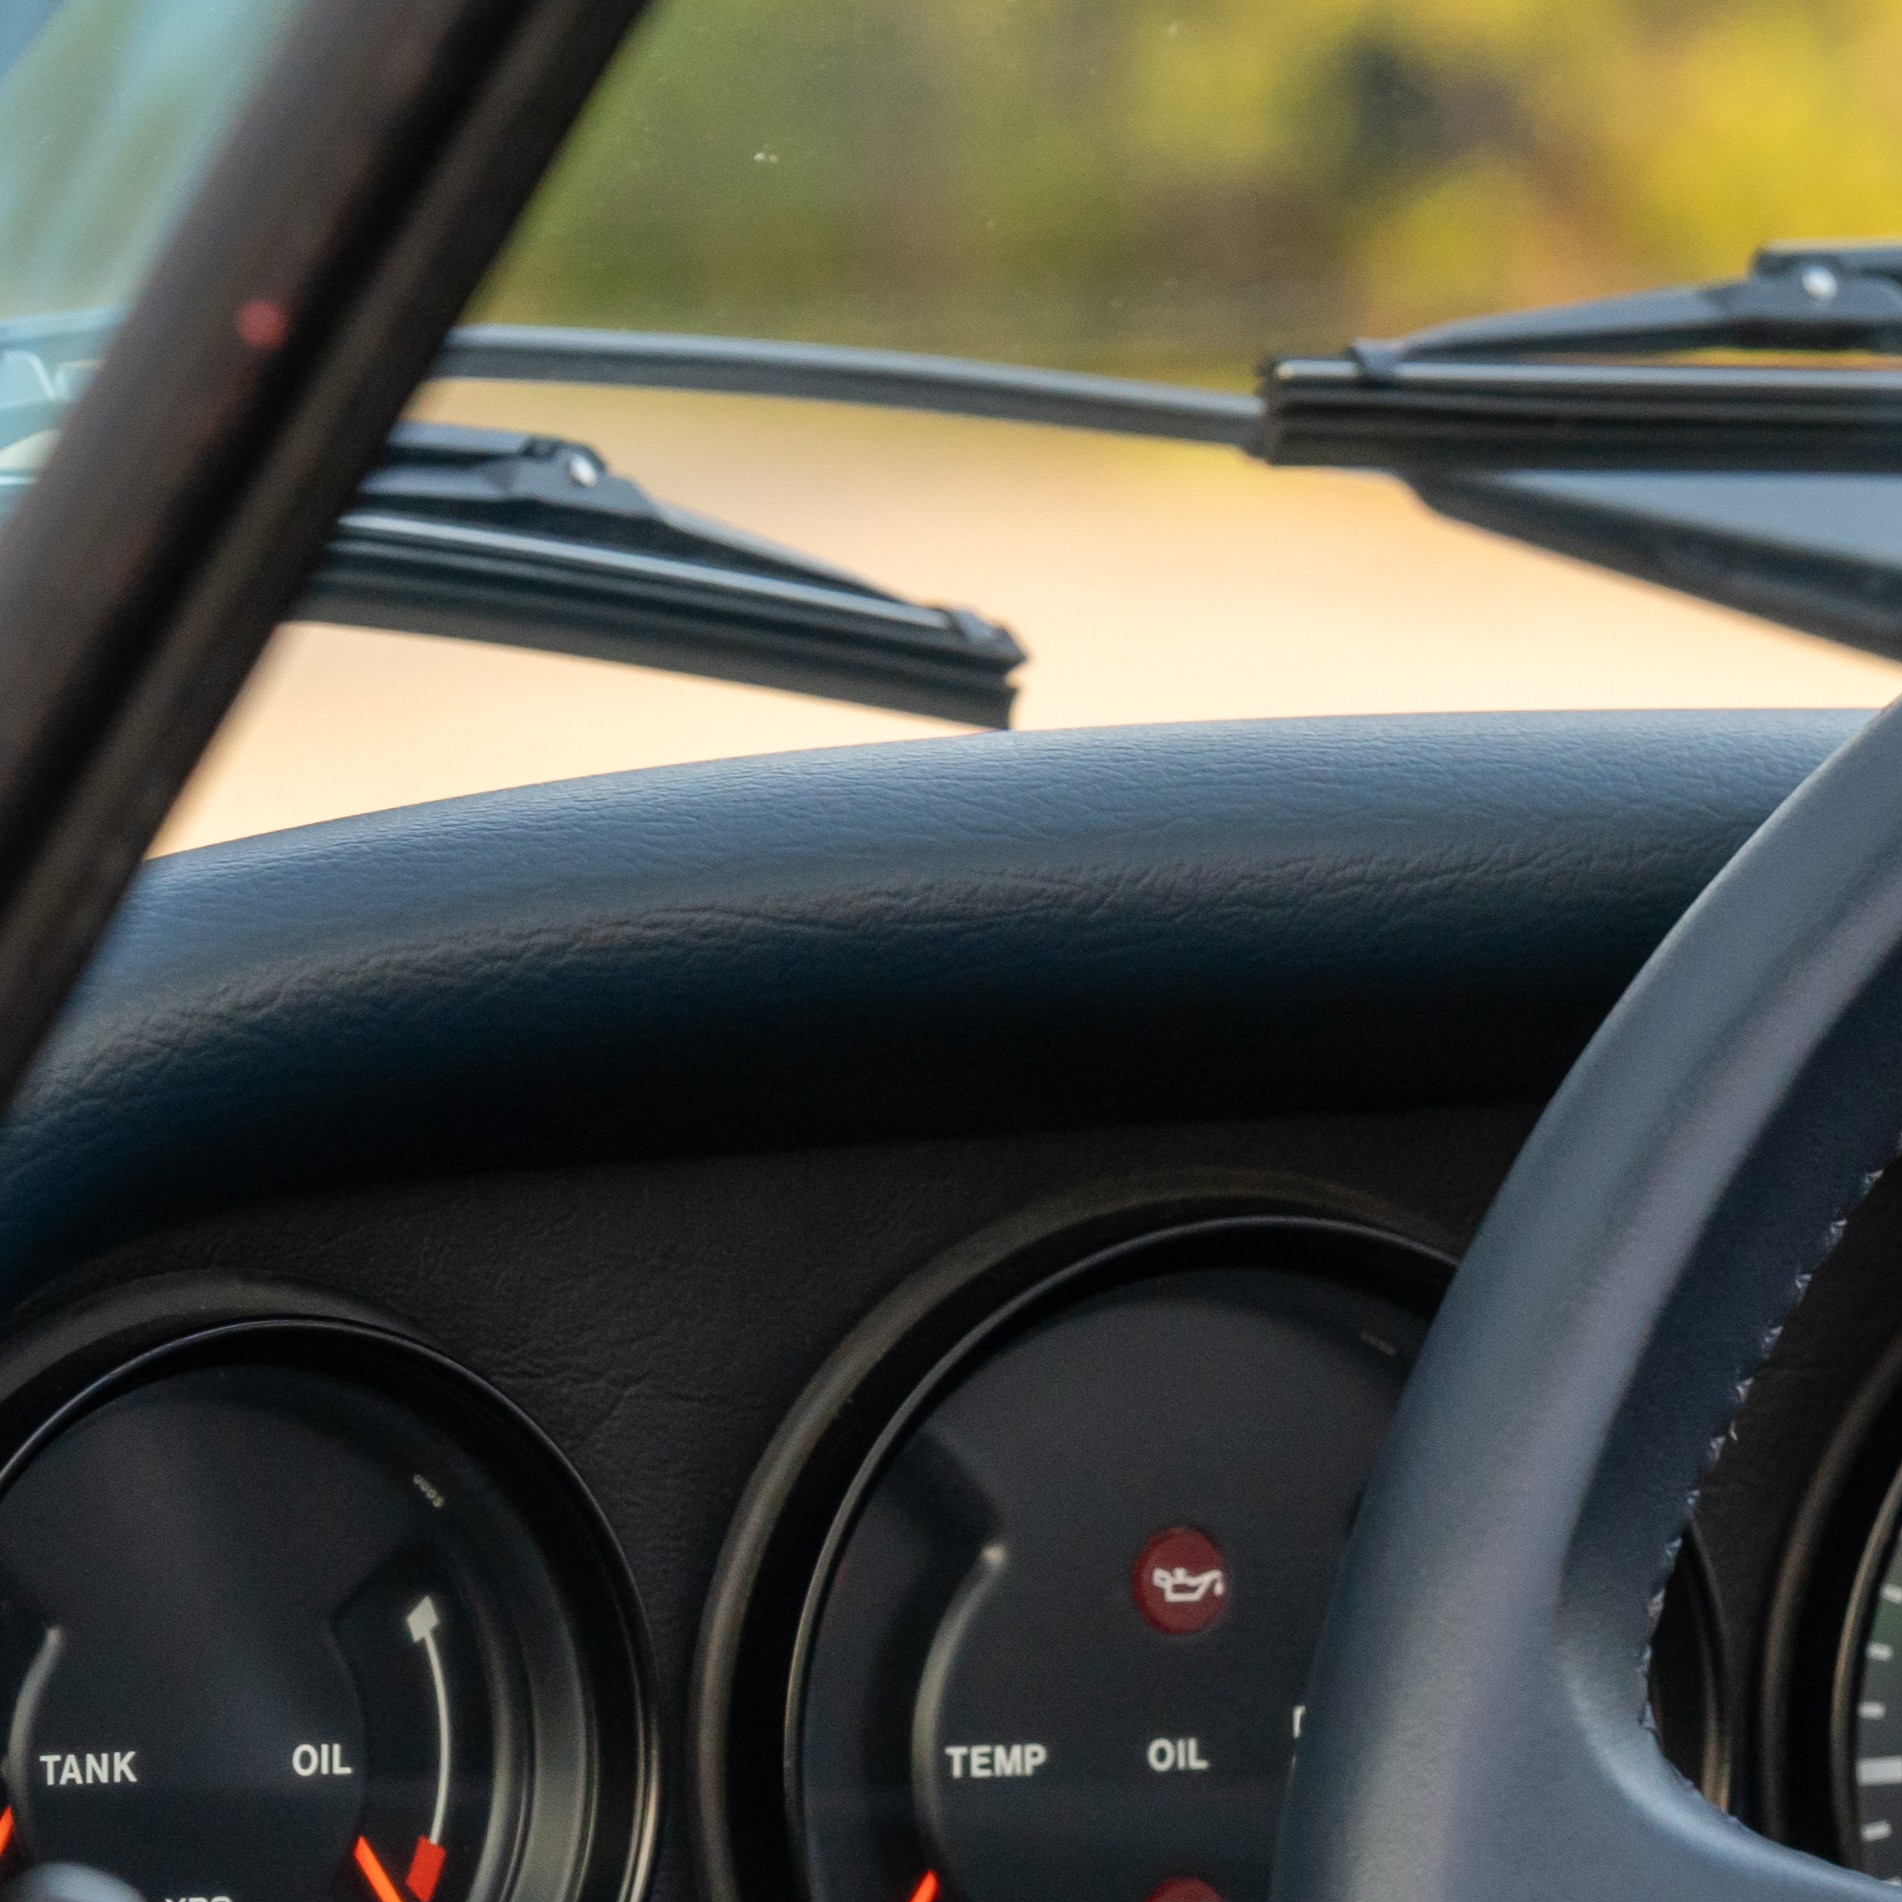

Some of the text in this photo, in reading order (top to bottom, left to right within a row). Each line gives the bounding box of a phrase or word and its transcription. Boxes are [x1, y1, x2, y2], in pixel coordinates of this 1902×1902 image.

[40, 1751, 137, 1785] TANK
[292, 1743, 352, 1777] OIL
[945, 1744, 1046, 1778] TEMP
[1147, 1738, 1208, 1771] OIL
